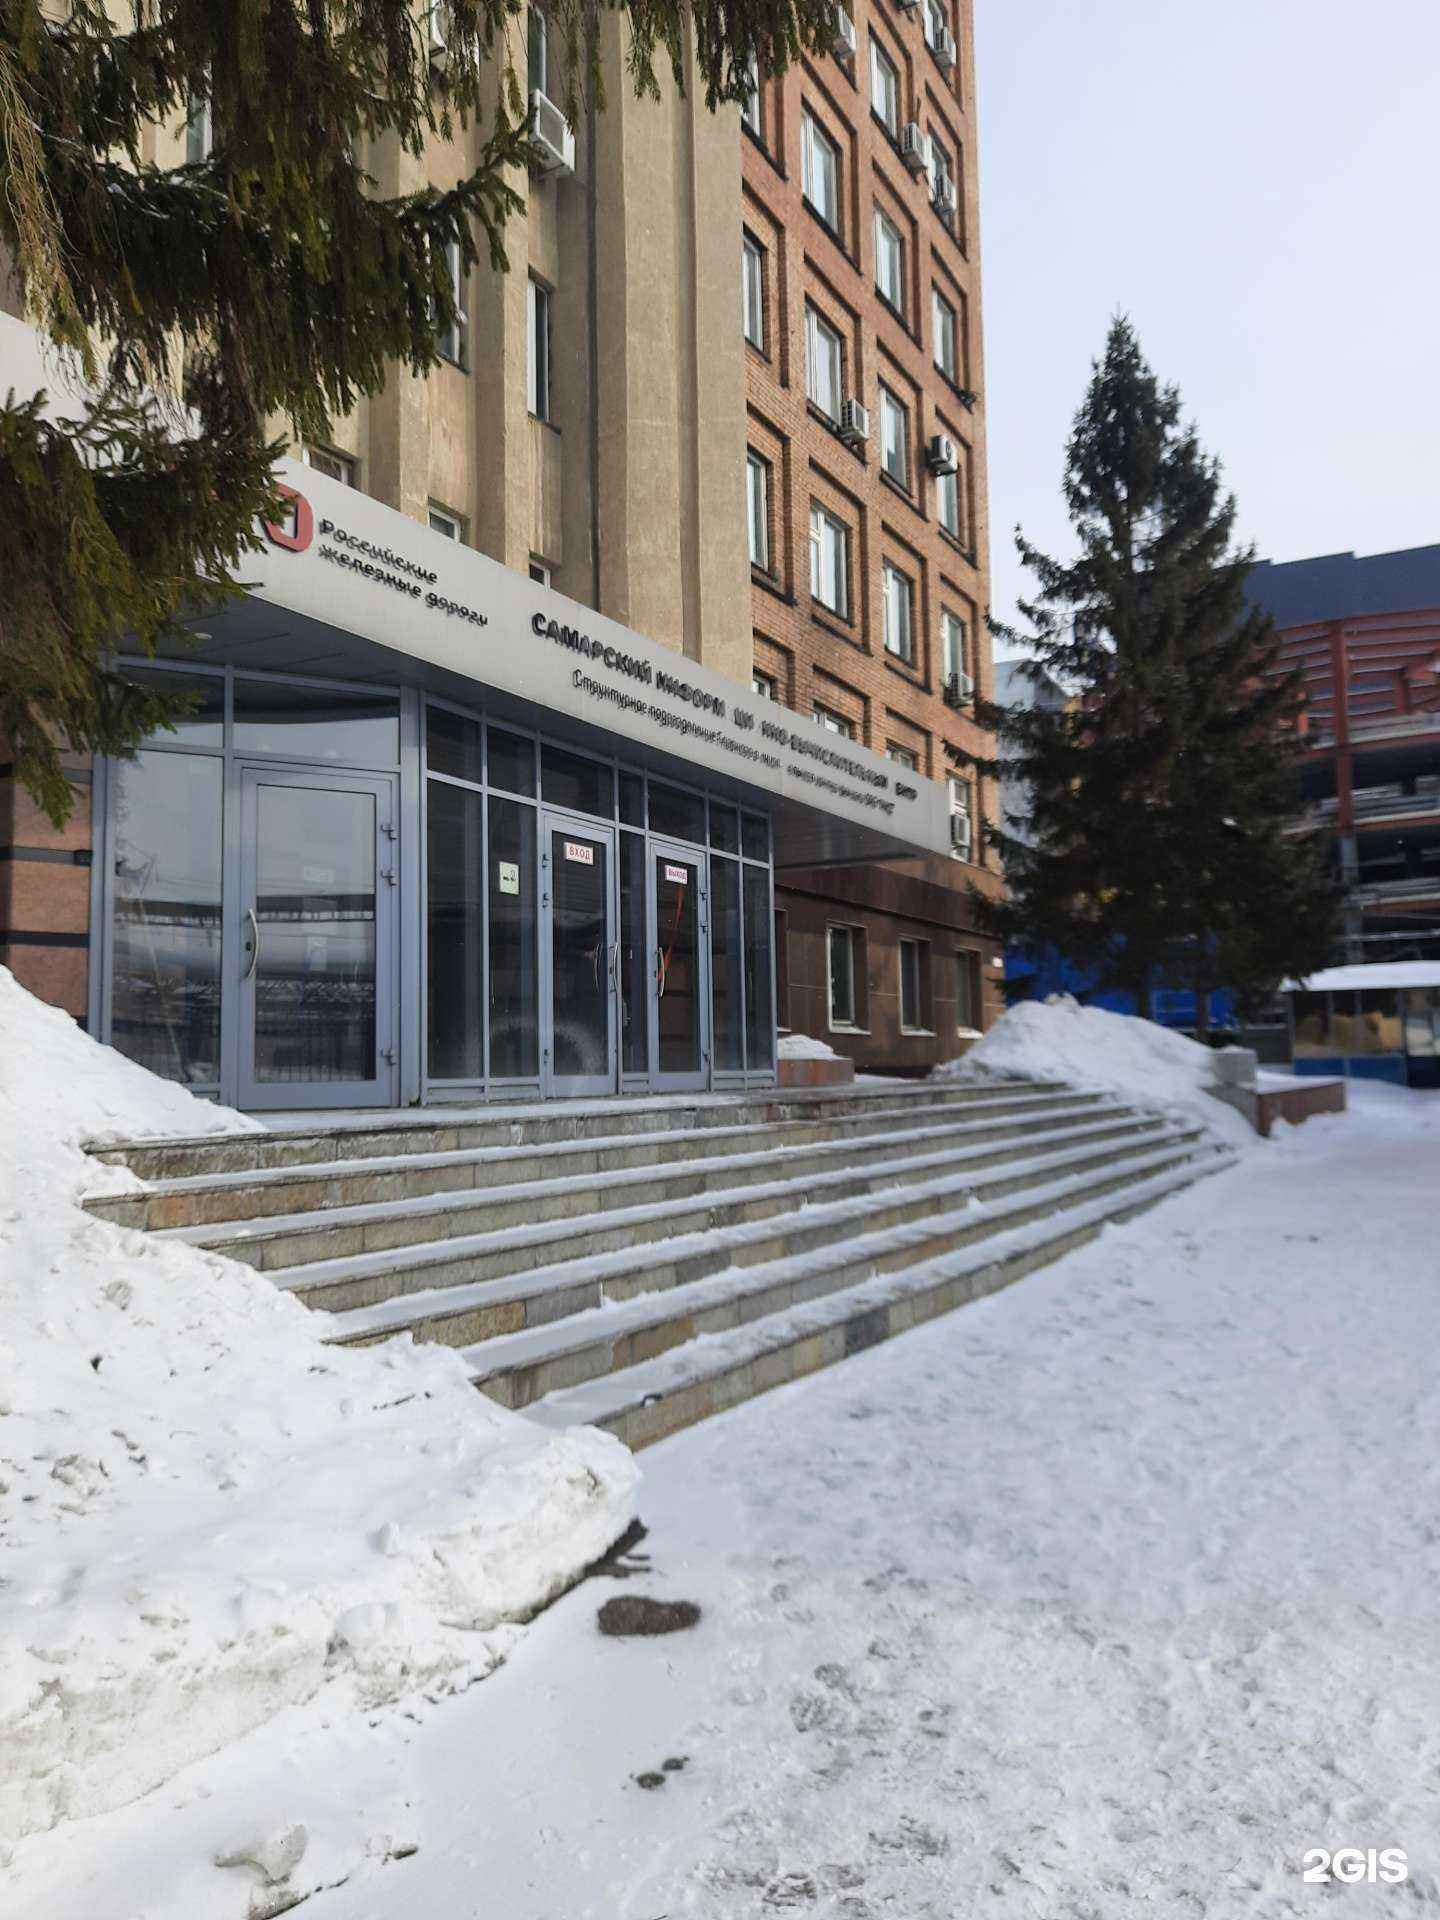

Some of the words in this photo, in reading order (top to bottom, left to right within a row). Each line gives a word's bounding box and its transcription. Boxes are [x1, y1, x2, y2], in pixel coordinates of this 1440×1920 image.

[319, 517, 438, 585] Российские
[319, 545, 422, 599] железные
[425, 590, 488, 628] дороги
[531, 612, 652, 684] САМАРСКИЙ
[569, 845, 591, 861] ВХОД
[668, 867, 688, 882] ВЫХОД
